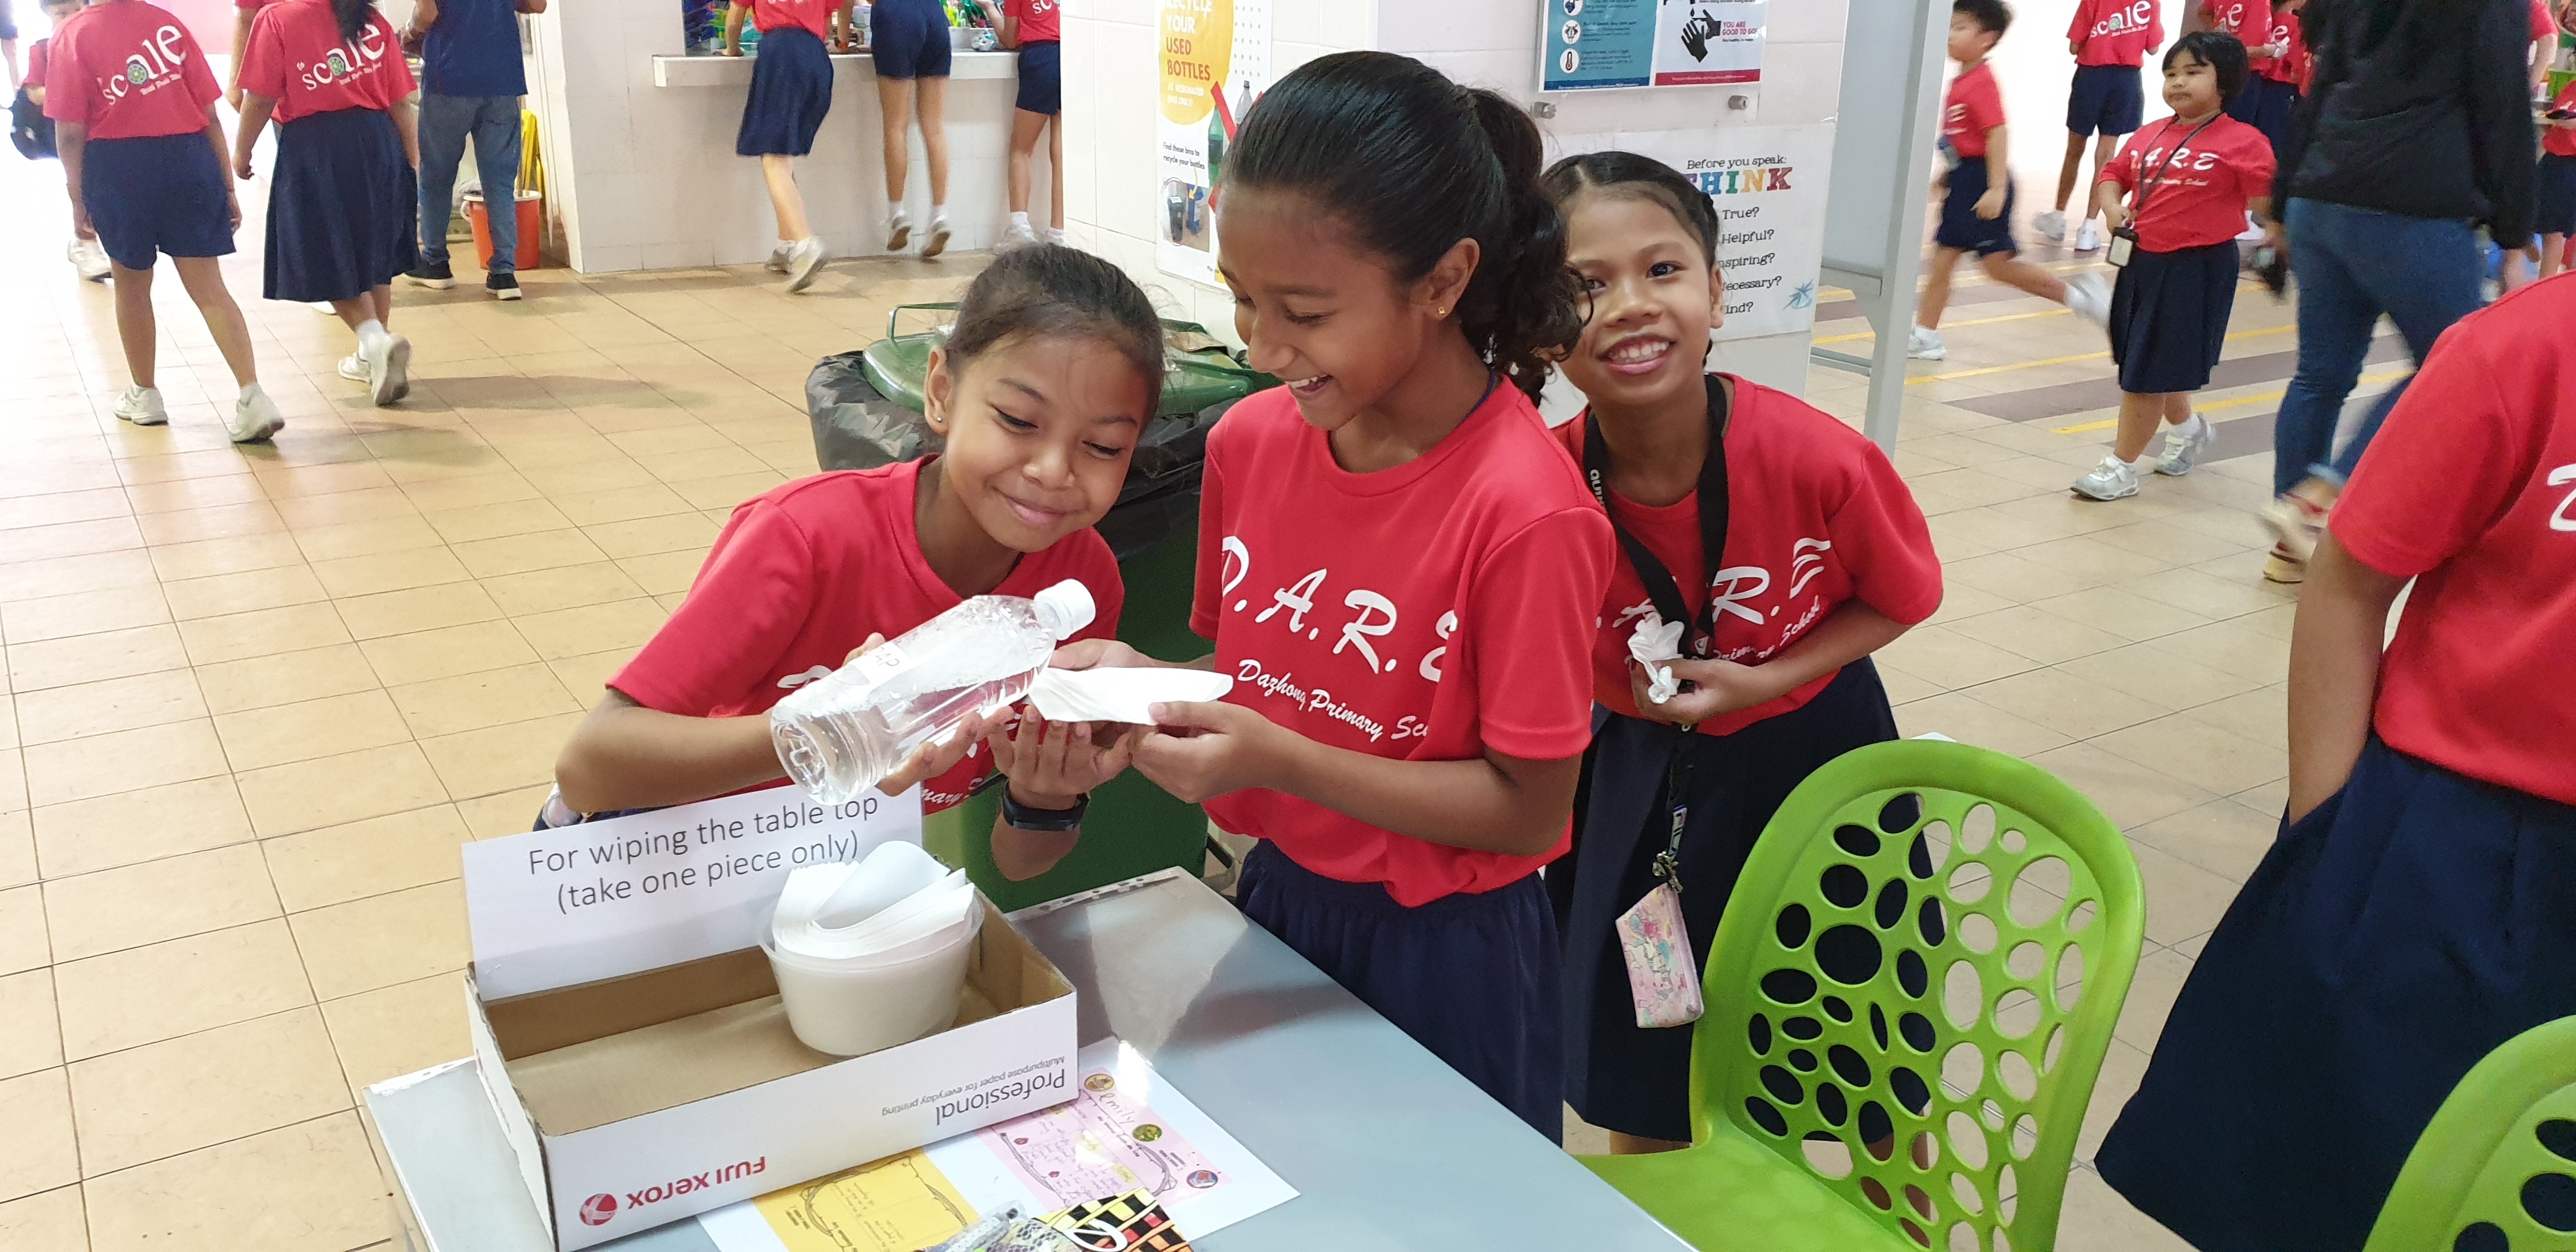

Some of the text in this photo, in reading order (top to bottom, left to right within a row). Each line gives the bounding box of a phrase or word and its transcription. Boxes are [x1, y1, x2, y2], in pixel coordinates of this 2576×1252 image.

[1167, 15, 1195, 34] YOUR
[1166, 36, 1192, 56] USED
[1167, 59, 1211, 81] BOTTLES
[1687, 155, 1787, 170] Before you speak:
[1722, 206, 1759, 220] True?
[1721, 229, 1774, 245] Helpful?
[1724, 302, 1754, 316] ind?
[1237, 659, 1307, 710] Dazhong
[1308, 689, 1384, 742] Primary
[529, 797, 878, 875] For wiping the table top
[558, 830, 858, 915] (take one piece only)
[882, 1056, 1065, 1117] Multipurpose paper for everyday printing
[936, 1069, 1065, 1126] Professional
[626, 1156, 766, 1210] FUJI xerox
